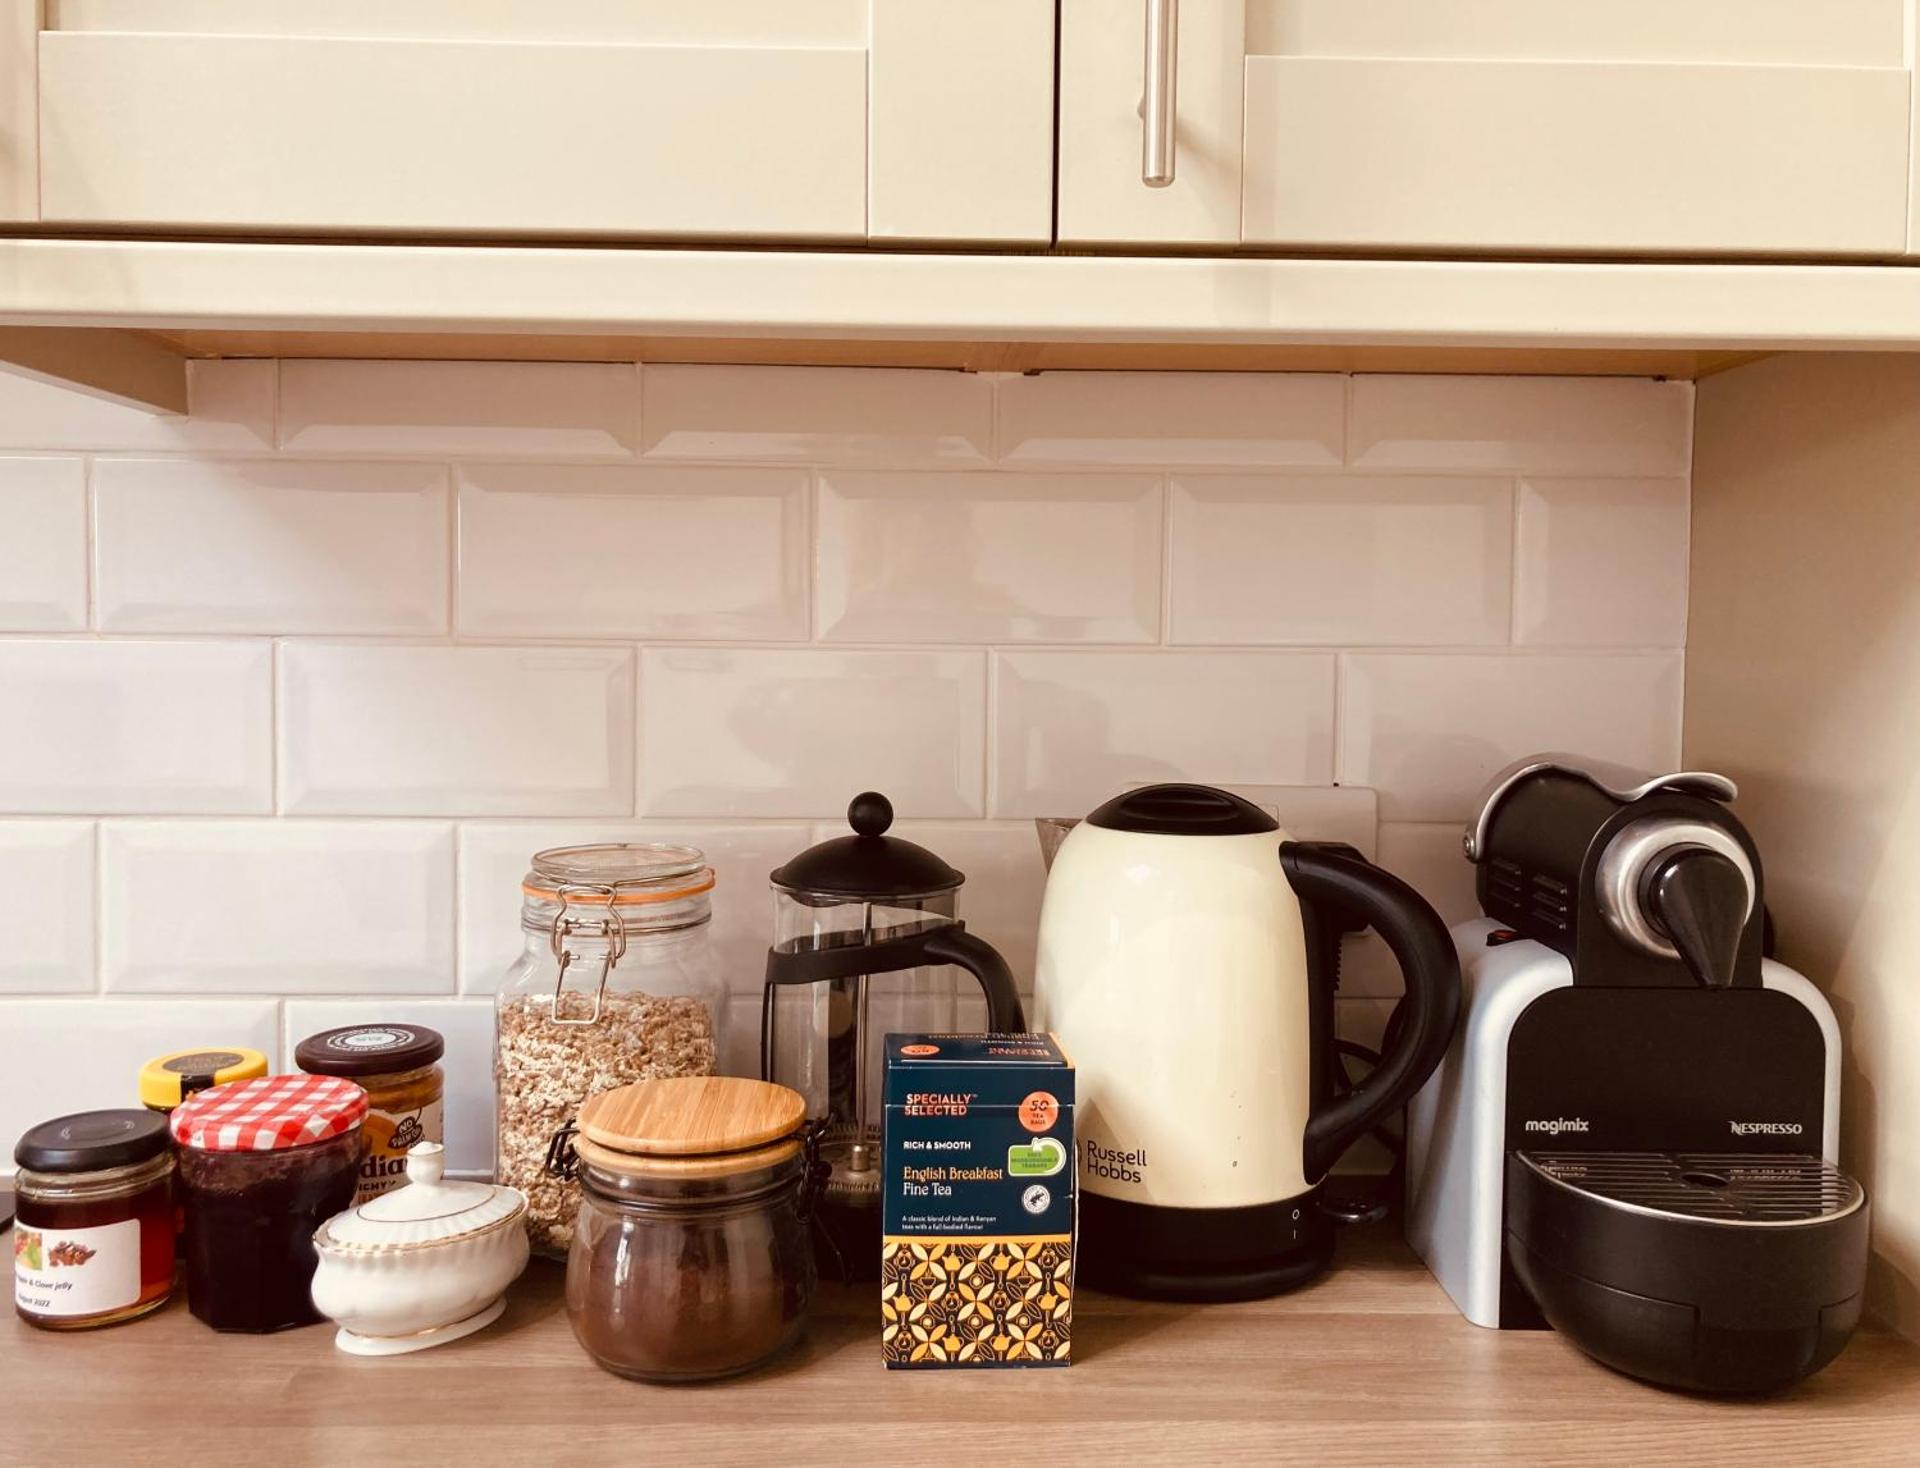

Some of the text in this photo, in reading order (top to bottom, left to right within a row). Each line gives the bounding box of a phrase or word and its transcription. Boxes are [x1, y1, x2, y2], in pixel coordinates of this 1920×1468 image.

[904, 1105, 968, 1116] SELECTED
[1030, 1100, 1049, 1112] 50
[398, 1118, 413, 1134] NO
[1525, 1117, 1589, 1135] magimix
[1728, 1120, 1803, 1136] NESPRESSO
[903, 1141, 972, 1150] RICH & SMOOTH
[1087, 1140, 1147, 1167] Russell
[903, 1166, 1003, 1182] English Breakfast
[1087, 1158, 1142, 1183] Hobbs
[903, 1182, 952, 1195] Fine Tea
[54, 1281, 73, 1291] jelly
